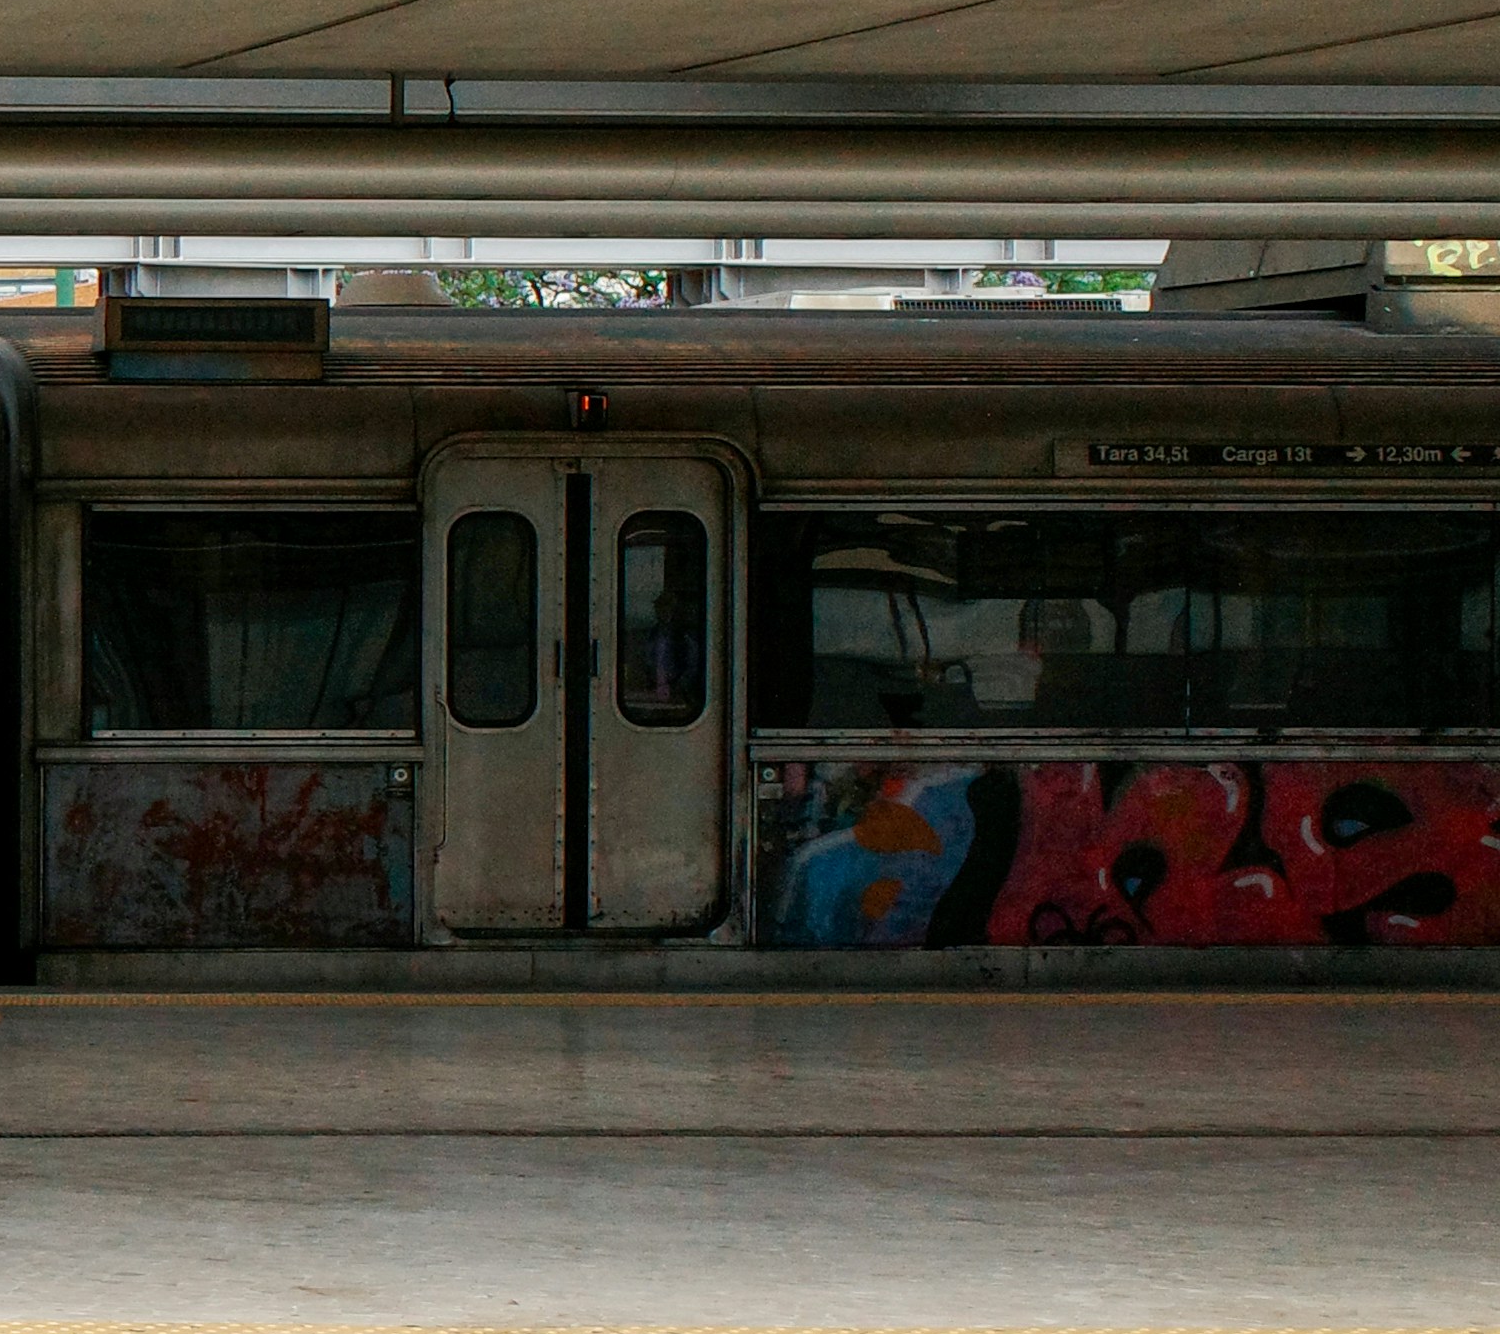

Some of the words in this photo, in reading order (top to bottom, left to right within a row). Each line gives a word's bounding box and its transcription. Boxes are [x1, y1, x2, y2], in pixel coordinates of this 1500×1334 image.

[1096, 445, 1139, 462] Tara
[1143, 445, 1190, 465] 34,5t
[1222, 445, 1279, 466] Carga
[1284, 445, 1313, 463] 13t
[1376, 446, 1443, 466] 12,30m
